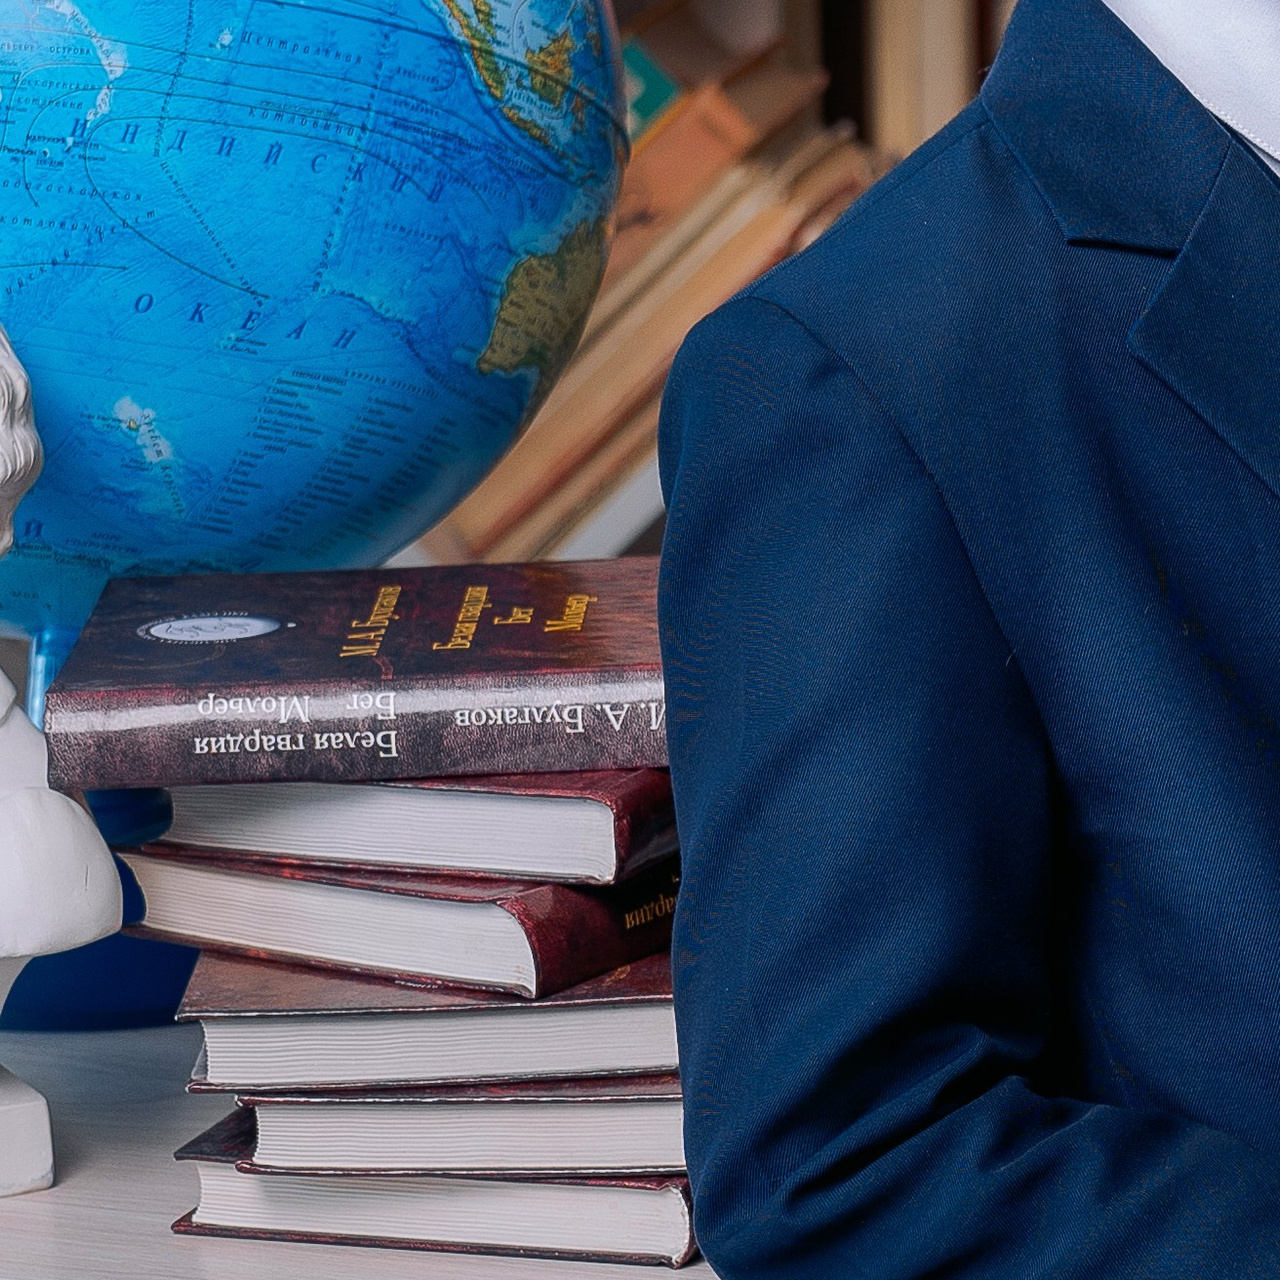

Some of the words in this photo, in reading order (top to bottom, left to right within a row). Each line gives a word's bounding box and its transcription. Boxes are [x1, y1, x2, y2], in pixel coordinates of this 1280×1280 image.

[70, 117, 446, 204] ИНДИЙСКИЙ
[2, 177, 144, 202] адагаскарская
[134, 292, 358, 350] ОКЕАН
[197, 692, 311, 724] Мольер
[346, 691, 397, 720] Бег
[454, 699, 585, 734] Булгаков
[596, 702, 630, 732] А.
[193, 727, 305, 754] гвардия
[314, 729, 399, 758] Белая
[625, 893, 677, 929] ардия
